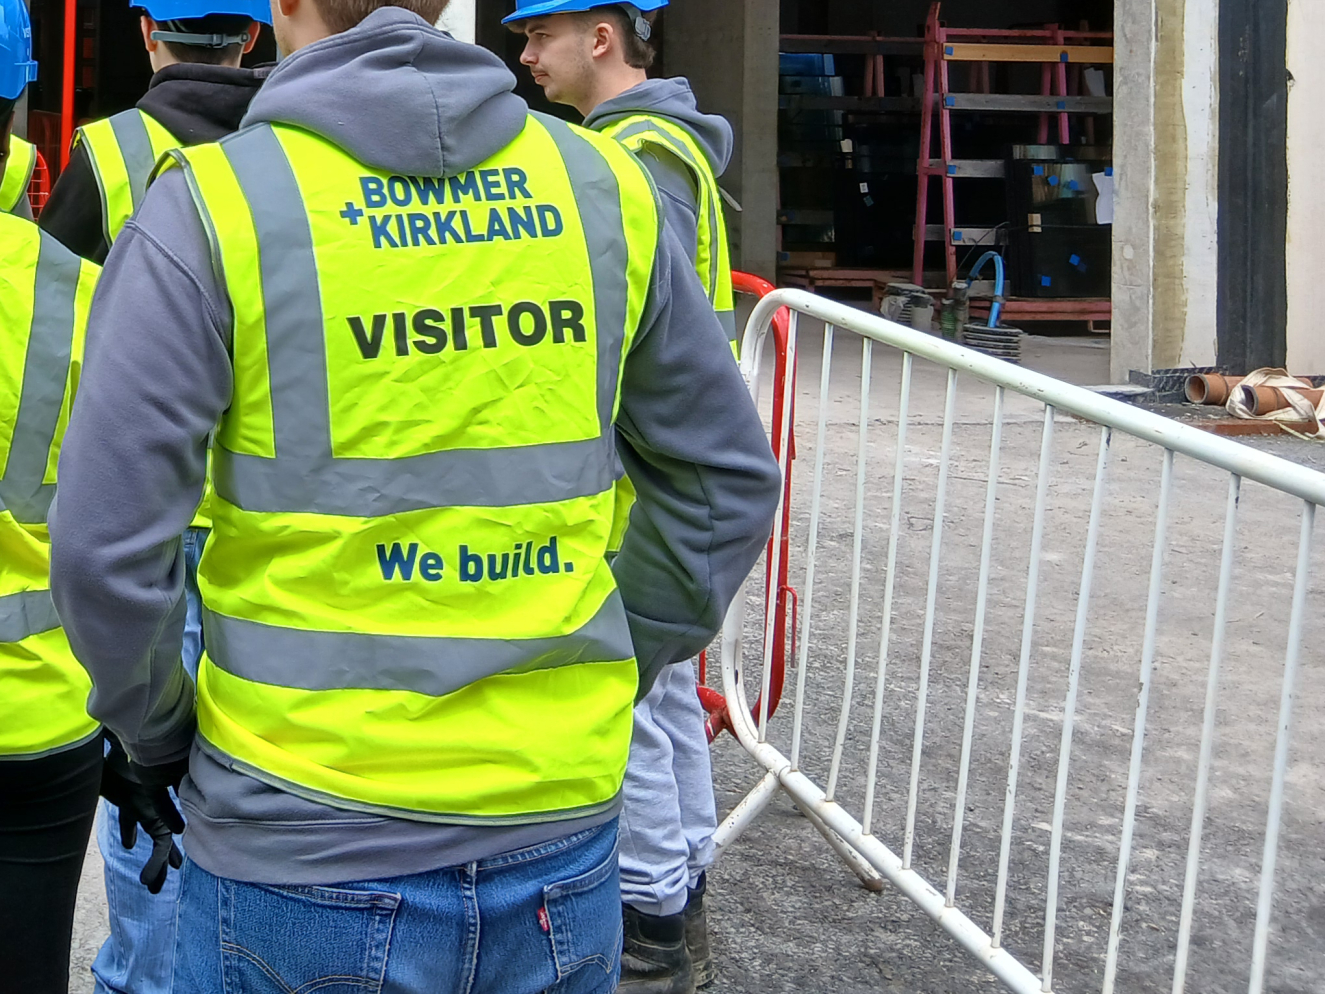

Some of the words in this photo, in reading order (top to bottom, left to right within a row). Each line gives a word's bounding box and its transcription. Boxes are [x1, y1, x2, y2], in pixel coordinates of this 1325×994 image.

[359, 167, 533, 208] BOWMER
[346, 300, 587, 359] VISITOR
[376, 542, 444, 581] We
[458, 535, 574, 582] build.
